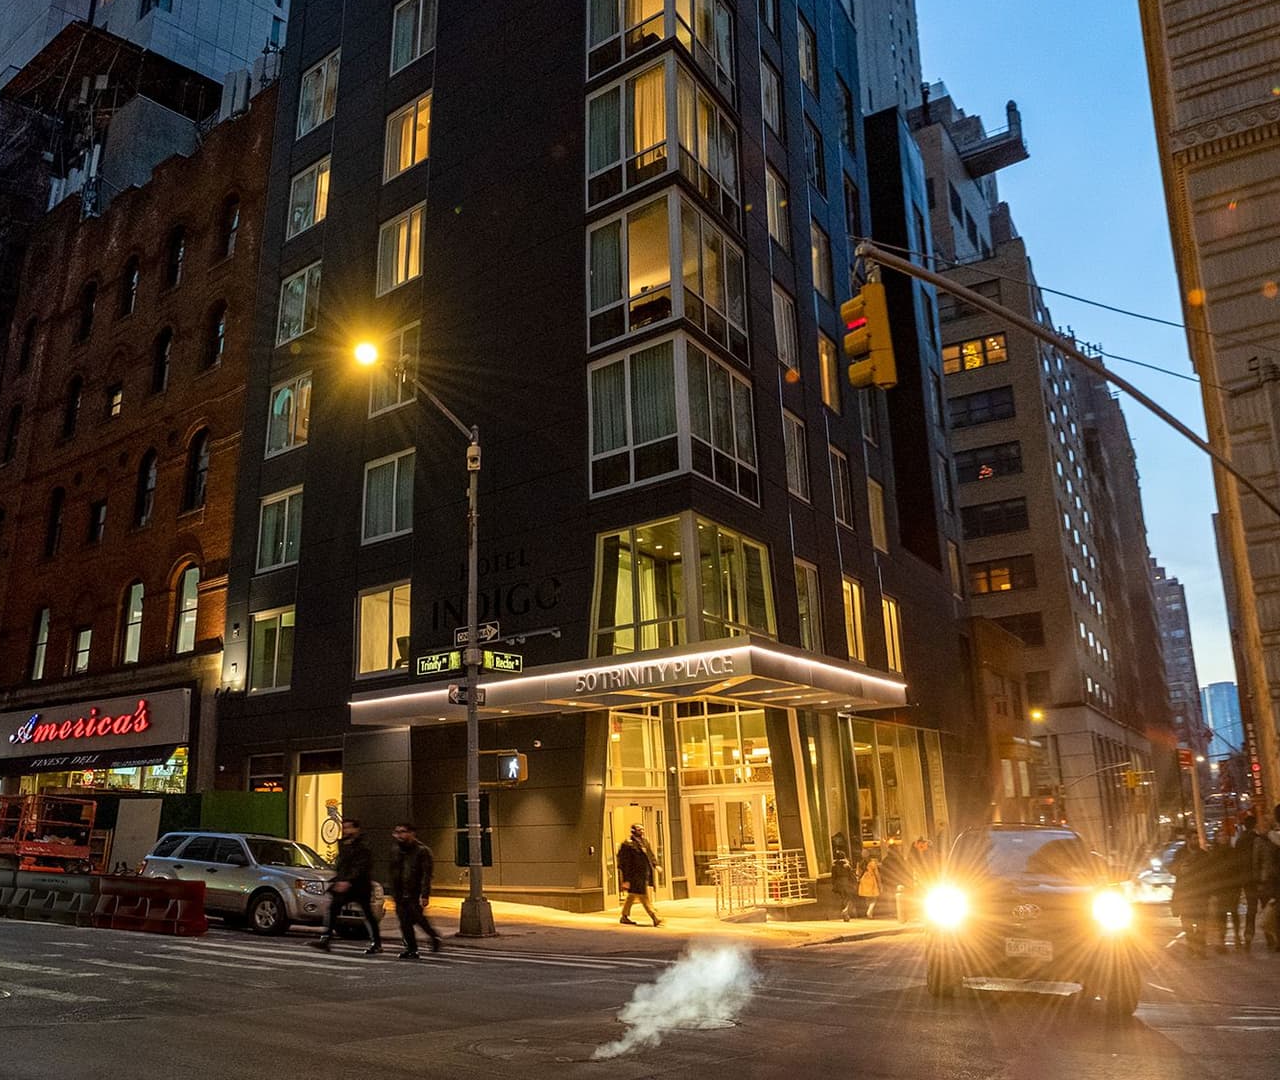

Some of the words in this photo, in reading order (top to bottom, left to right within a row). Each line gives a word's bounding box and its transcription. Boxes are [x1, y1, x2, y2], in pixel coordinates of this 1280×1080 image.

[432, 576, 561, 631] INDIGO
[420, 658, 443, 671] Trinity
[495, 657, 515, 670] Rector
[575, 672, 597, 693] 50
[598, 663, 671, 690] TRINITY
[672, 655, 734, 680] PLACE
[7, 699, 151, 745] America's
[30, 756, 71, 768] FINEST
[71, 753, 101, 766] DELI
